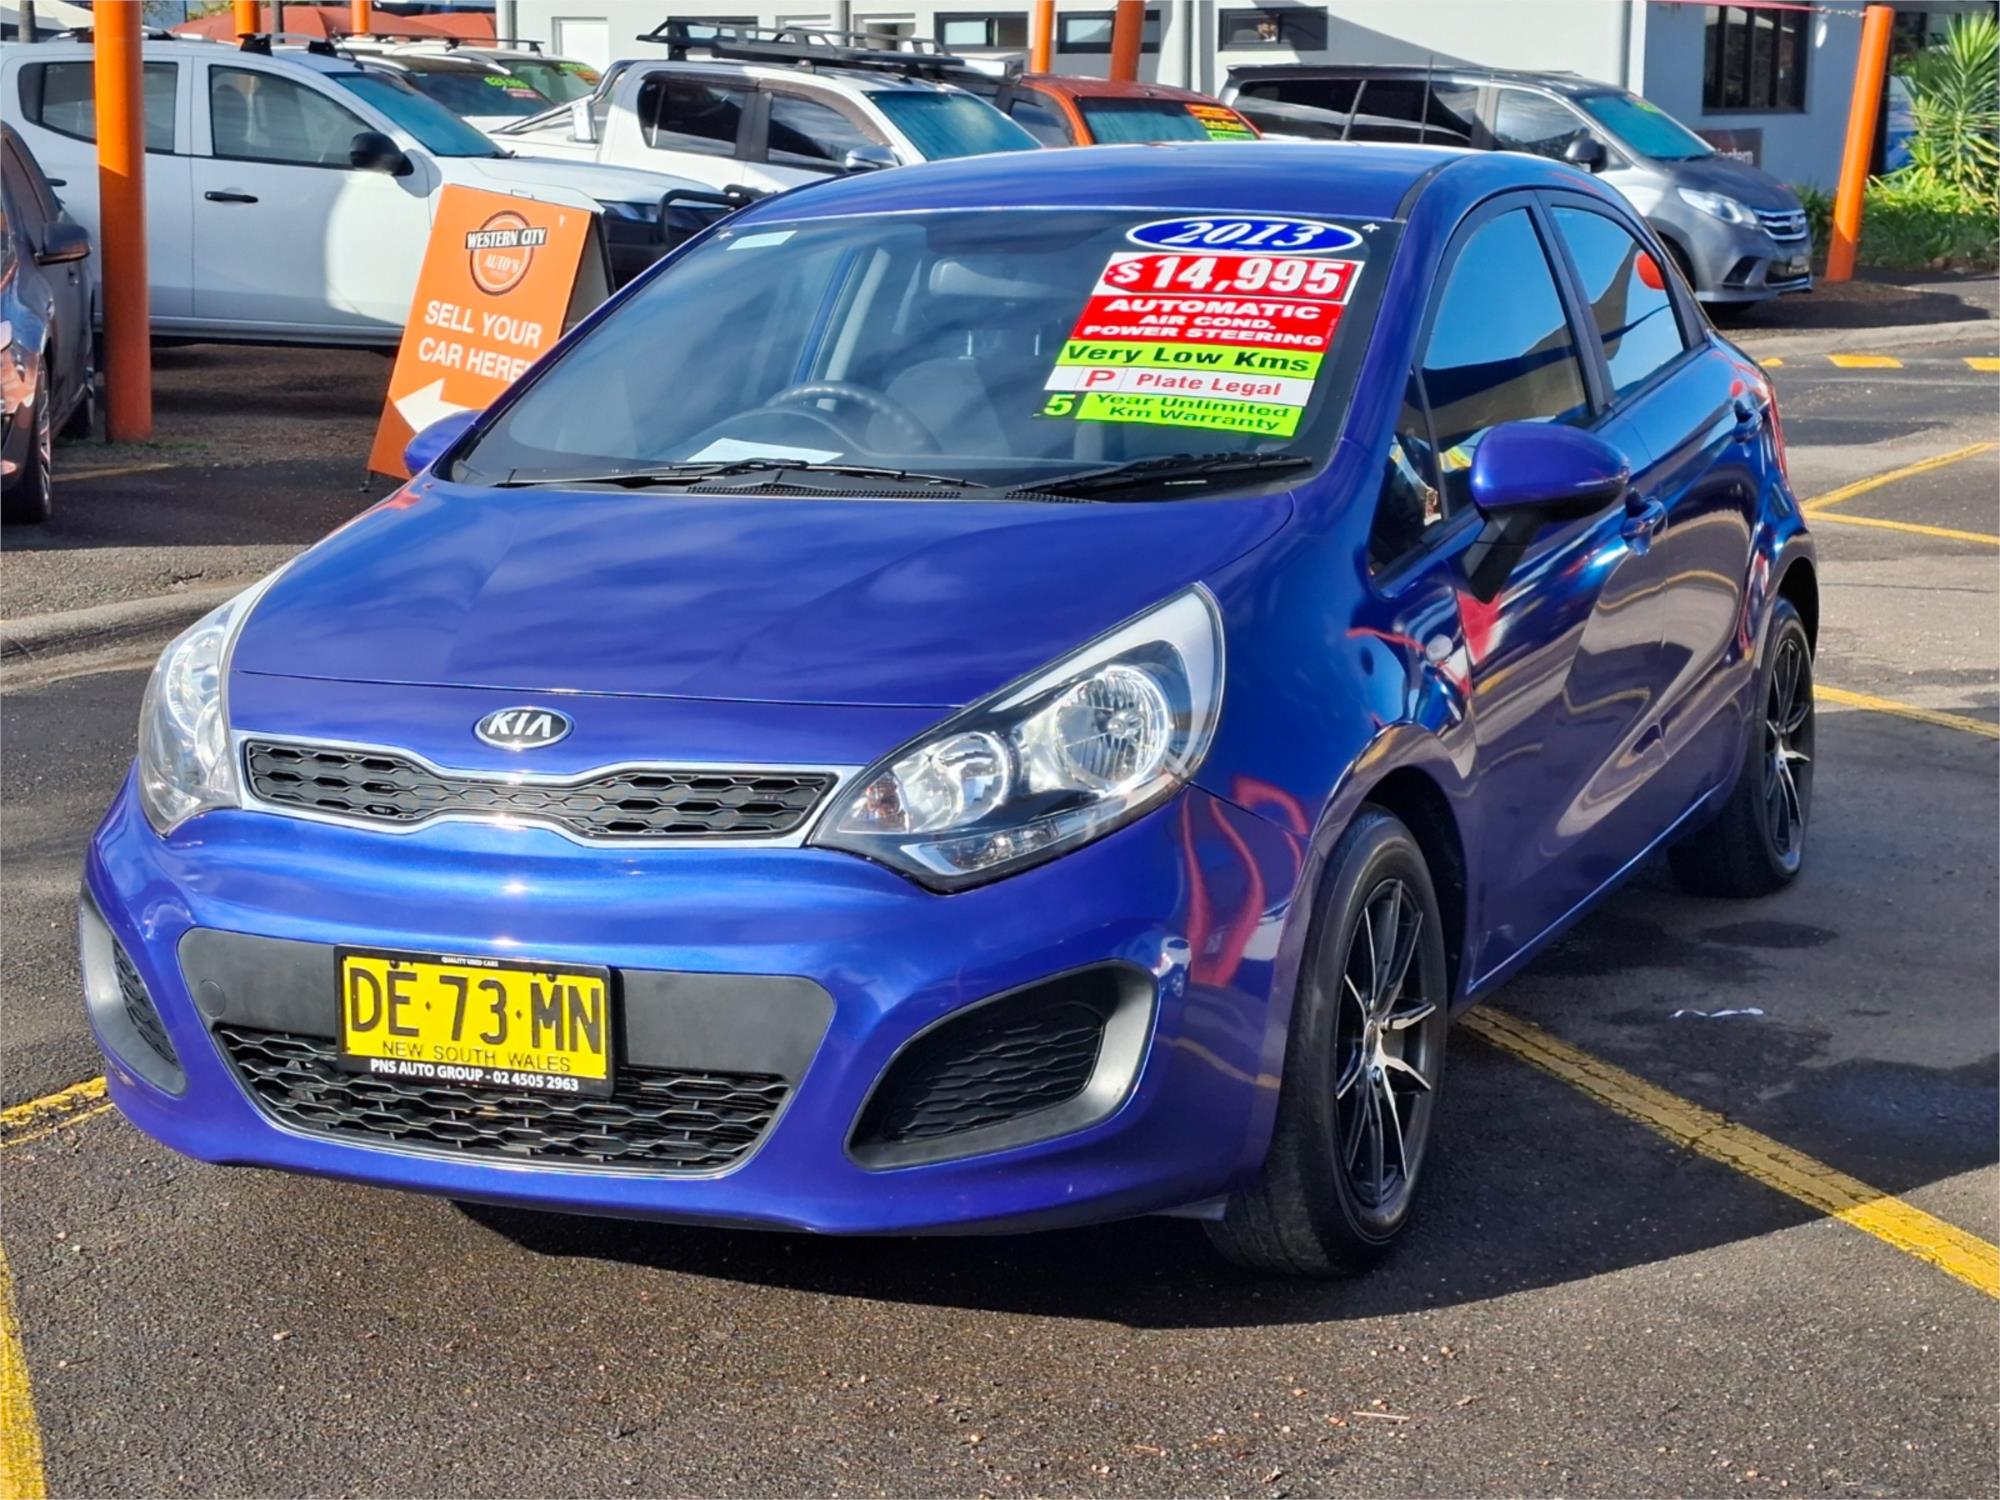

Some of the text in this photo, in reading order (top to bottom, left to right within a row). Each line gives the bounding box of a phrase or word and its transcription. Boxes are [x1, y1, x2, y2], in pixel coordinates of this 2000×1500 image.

[467, 228, 546, 248] WESTERN CITY
[1160, 222, 1325, 247] 2013
[485, 254, 520, 274] AUTO'S
[1103, 299, 1321, 320] AUTOMATIC
[424, 300, 542, 349] SELL YOUR
[1138, 315, 1277, 330] AIR COND.
[1083, 325, 1180, 337] POWER
[1184, 328, 1324, 346] STEERING
[418, 337, 463, 369] CAR
[1067, 345, 1310, 372] Very Low Kms
[1084, 370, 1282, 396] P Plate Legal
[1043, 392, 1077, 416] 5
[1097, 394, 1290, 418] Year Unlimited
[1108, 406, 1279, 431] Km Warranty
[487, 711, 552, 738] KIA
[382, 1039, 570, 1073] NEW SOUTH WALES
[370, 1057, 396, 1074] PNS
[398, 1060, 435, 1077] AUTO
[437, 1064, 484, 1082] GROUP
[492, 1070, 510, 1084] 02
[511, 1073, 544, 1089] 4505
[546, 1076, 579, 1092] 2963
